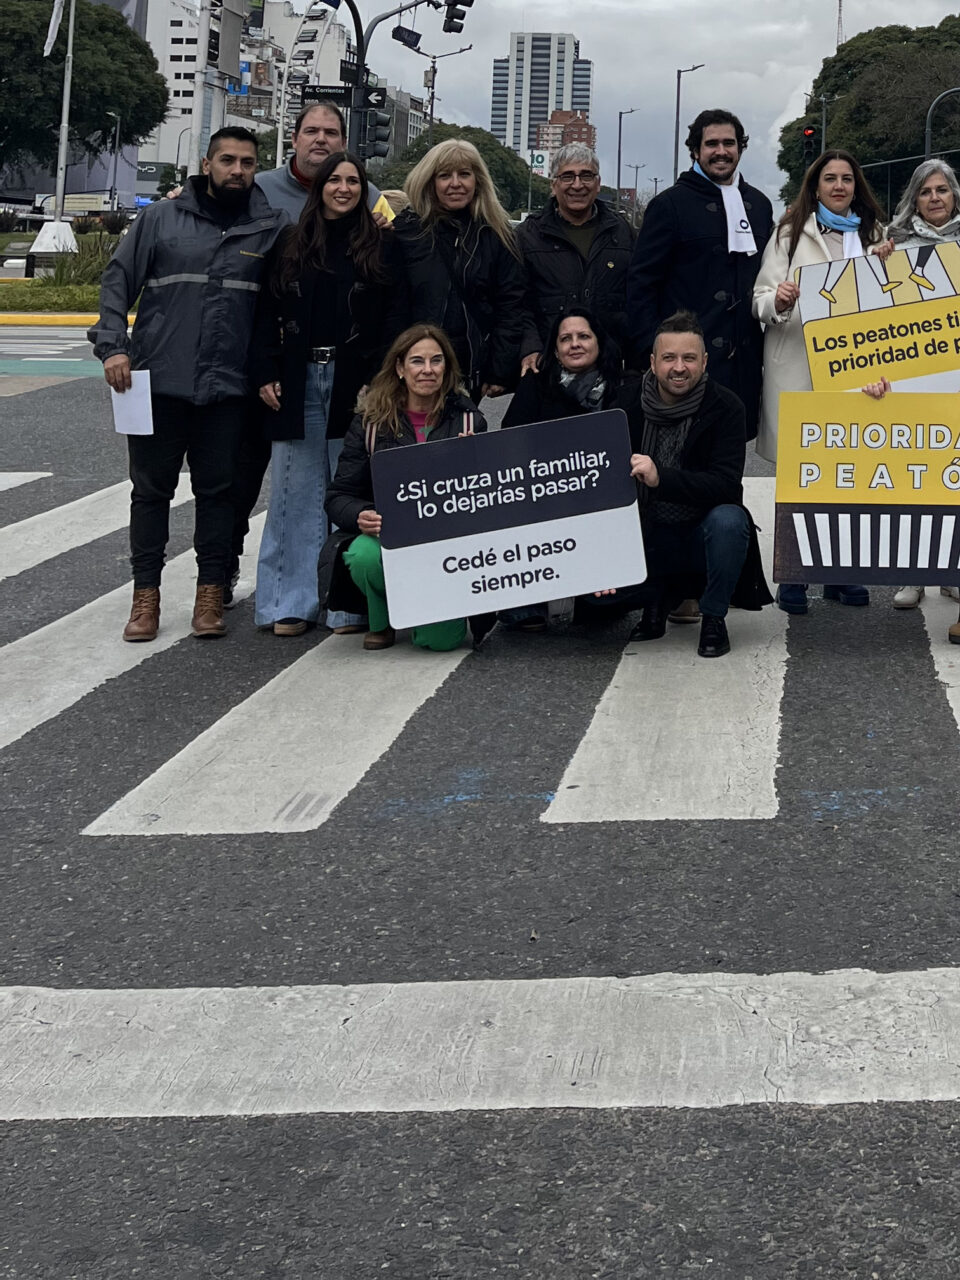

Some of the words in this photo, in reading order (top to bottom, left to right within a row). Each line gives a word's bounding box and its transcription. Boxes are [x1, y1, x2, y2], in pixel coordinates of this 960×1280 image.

[812, 334, 848, 353] Los
[852, 318, 943, 349] peatones
[828, 342, 919, 377] prioridad
[924, 338, 949, 356] de
[396, 481, 428, 502] ¿Si
[433, 472, 492, 495] cruza
[497, 465, 524, 484] un
[529, 450, 611, 478] familiar,
[417, 498, 437, 519] lo
[443, 485, 526, 515] dejarías
[531, 469, 600, 501] pasar?
[442, 548, 497, 574] Cedé
[503, 544, 521, 563] el
[527, 537, 577, 562] paso
[470, 566, 561, 594] siempre.
